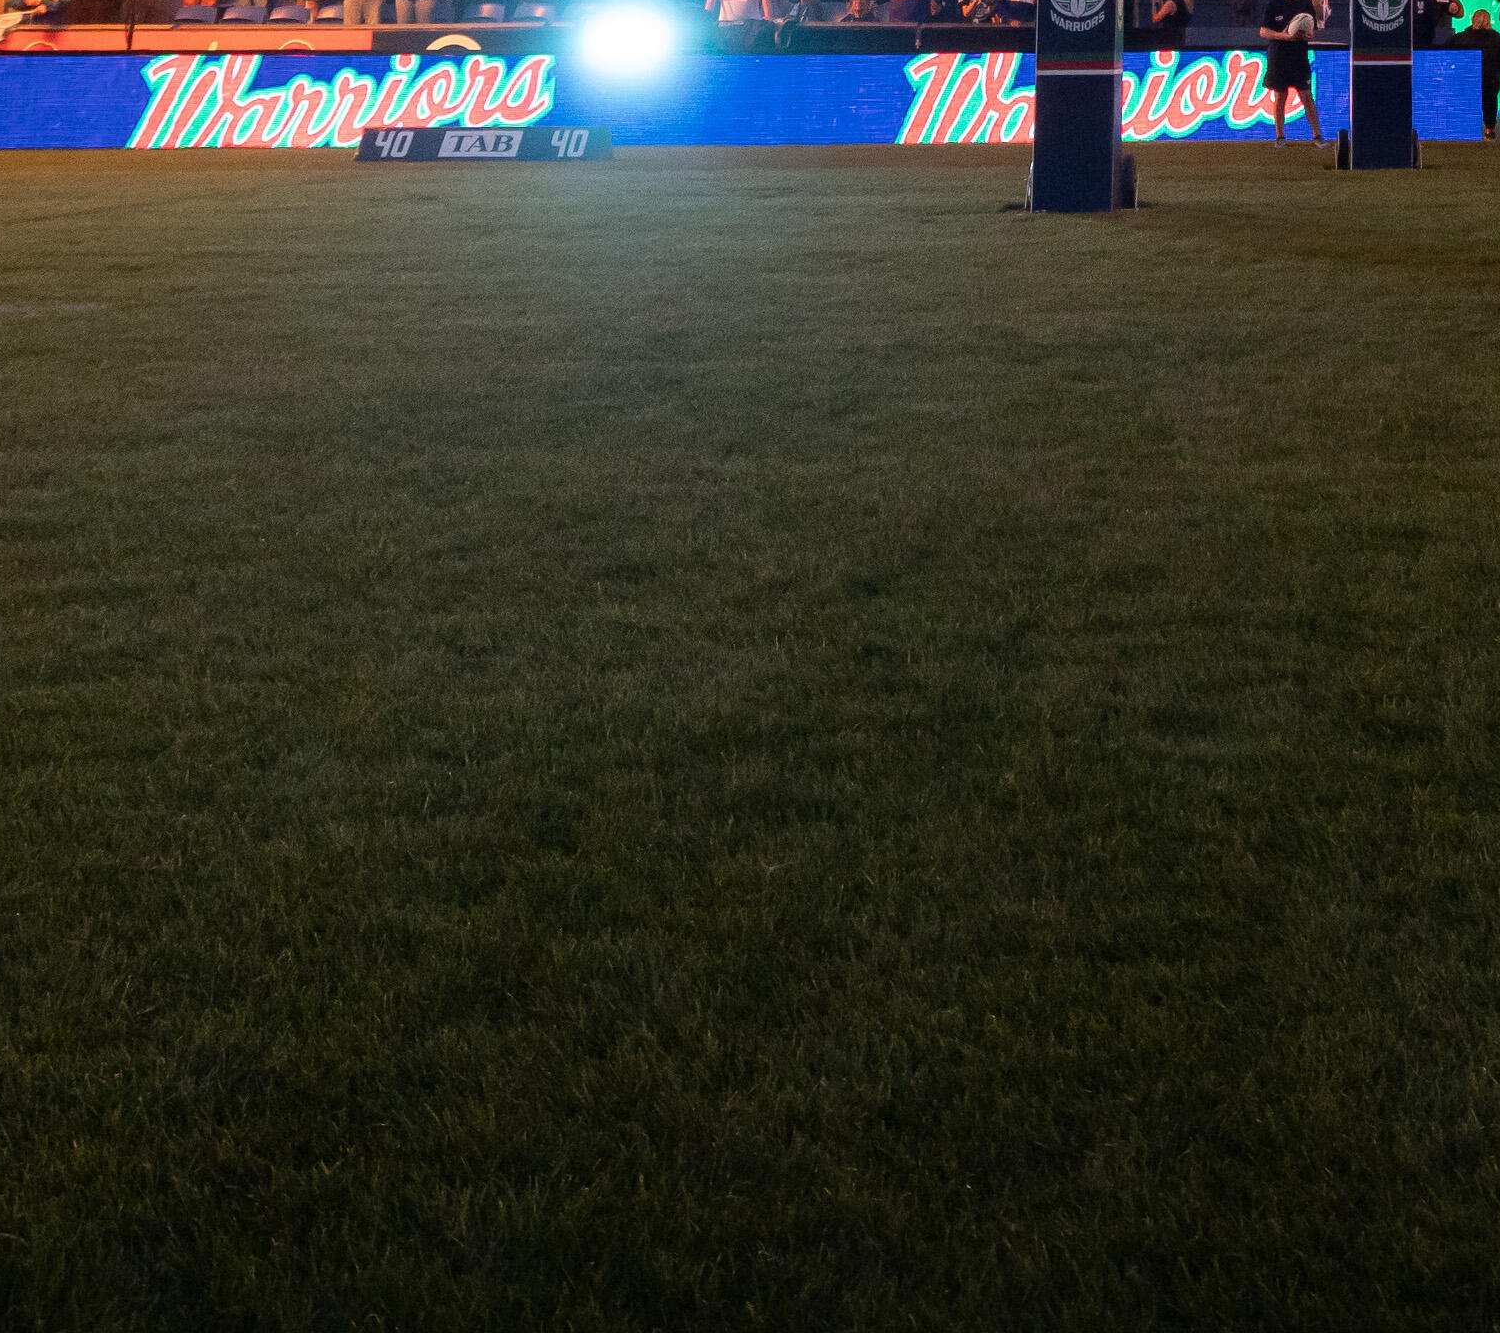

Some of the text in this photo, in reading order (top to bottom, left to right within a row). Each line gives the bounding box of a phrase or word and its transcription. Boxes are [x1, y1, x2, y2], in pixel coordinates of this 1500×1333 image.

[1050, 11, 1105, 32] WARRIORS
[1361, 15, 1404, 32] WARRIORS
[127, 55, 555, 148] Warriors
[375, 130, 590, 157] 40 TAB 40
